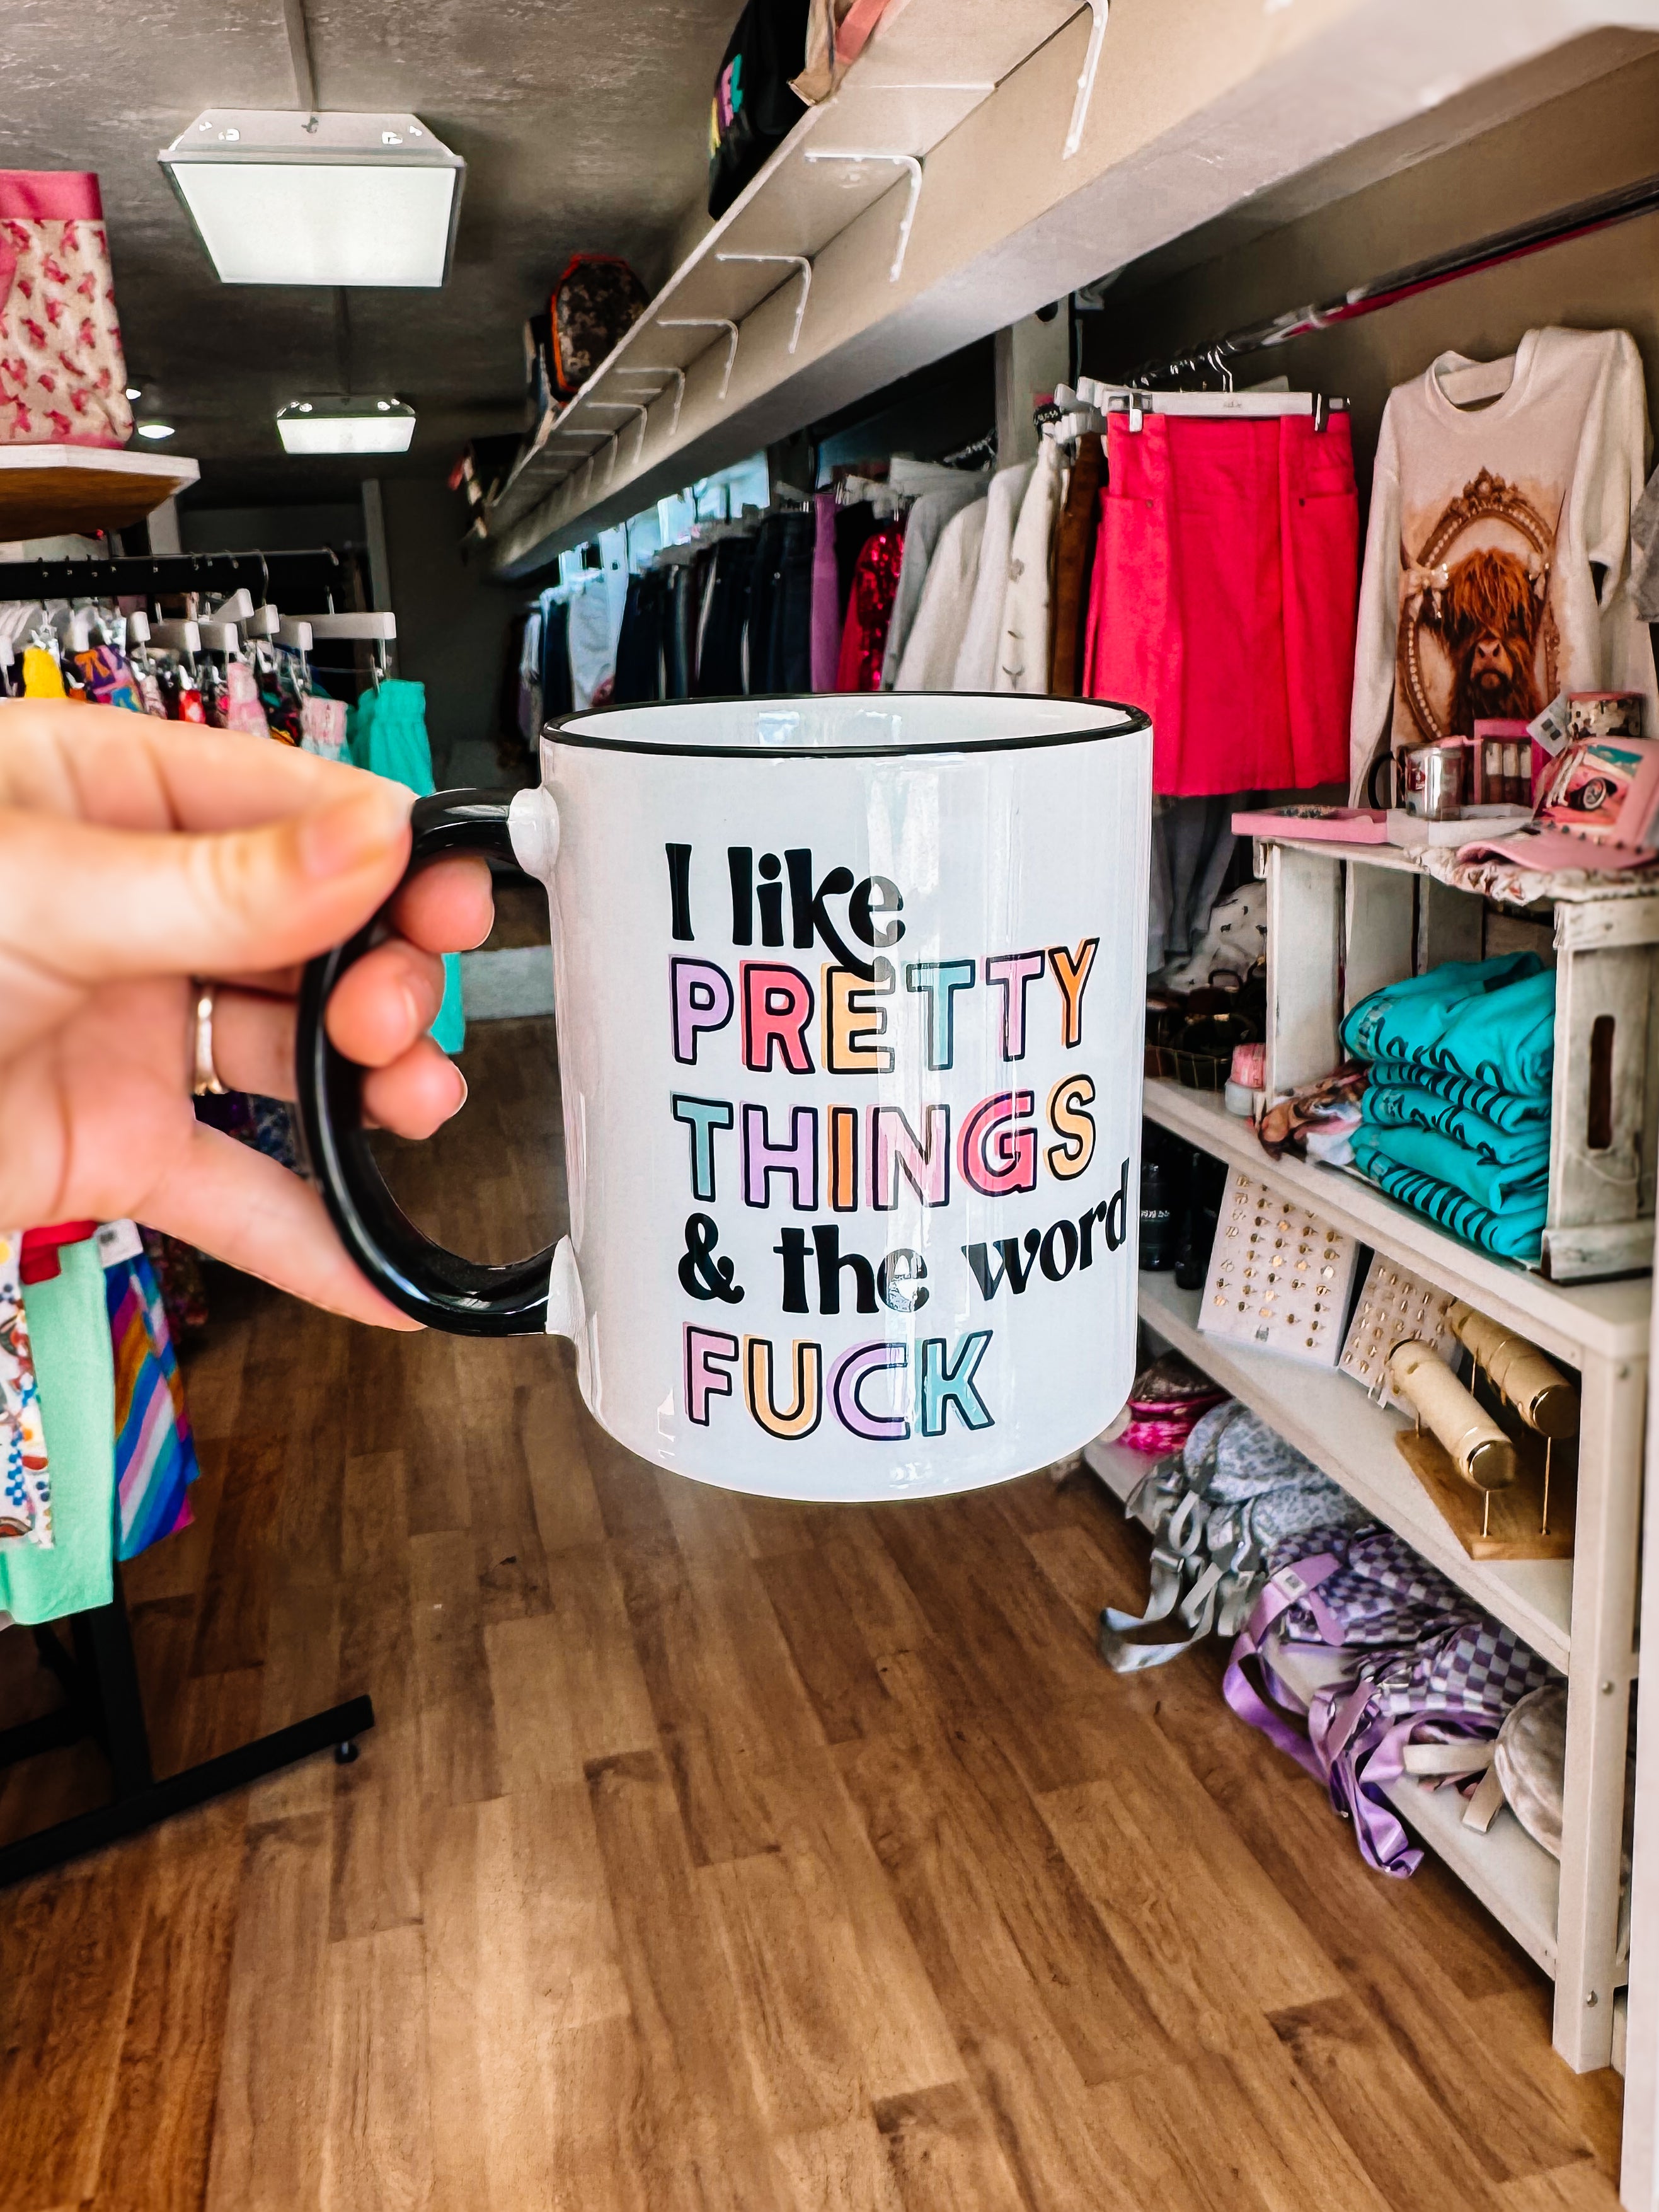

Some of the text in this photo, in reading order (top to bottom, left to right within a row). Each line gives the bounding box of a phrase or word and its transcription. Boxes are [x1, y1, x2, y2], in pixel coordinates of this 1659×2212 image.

[665, 842, 906, 981] I like
[670, 937, 1100, 1074] PRETTY
[672, 1075, 1097, 1211] THINGS
[677, 1160, 1130, 1314] & the word
[685, 1322, 996, 1440] FUCK
